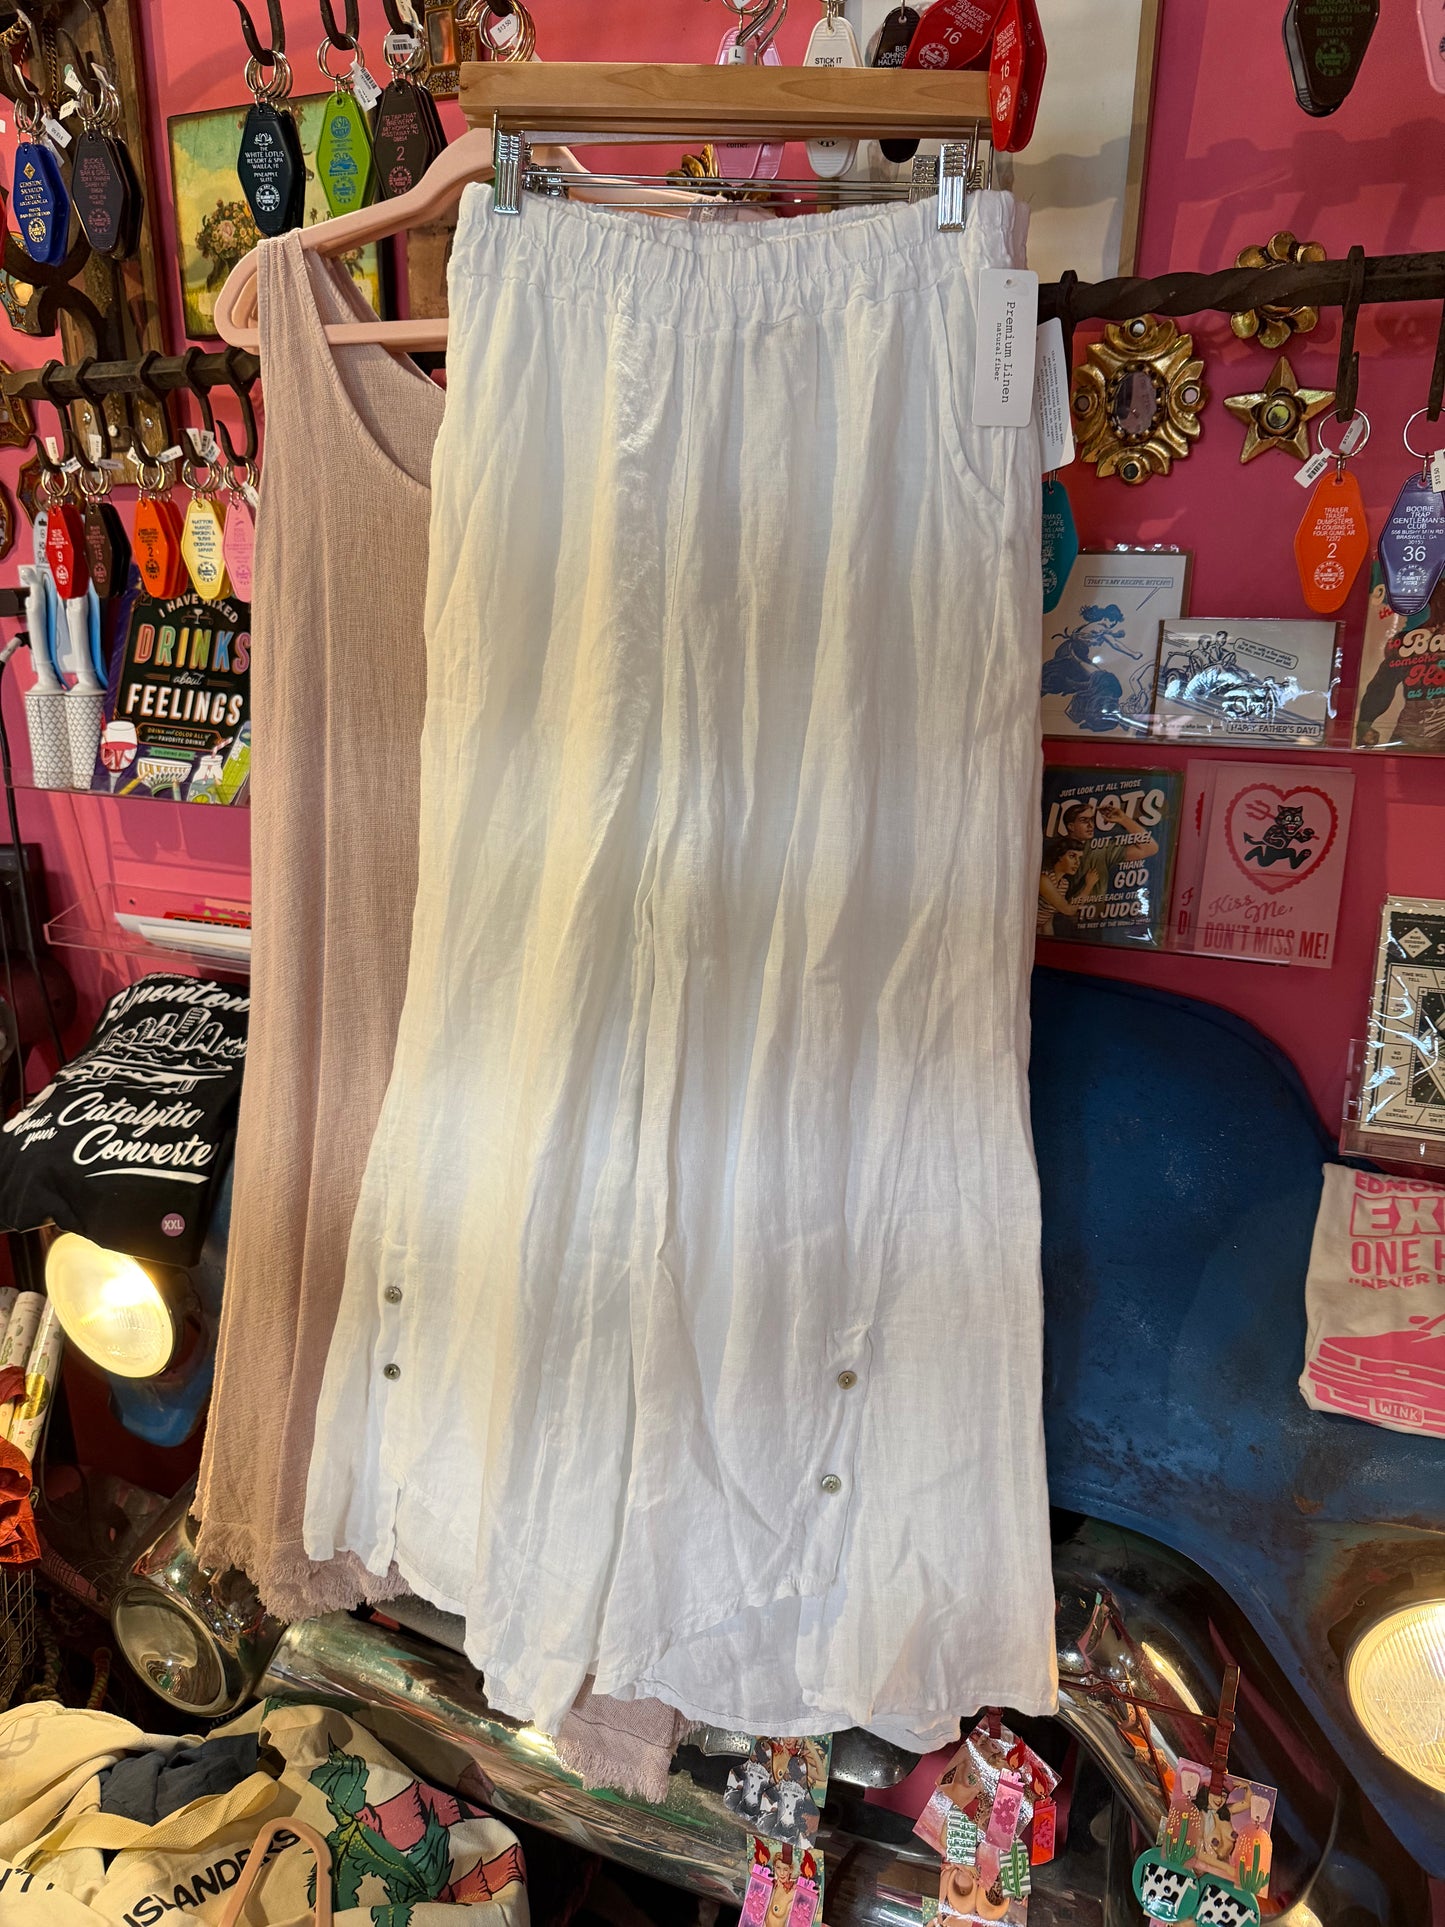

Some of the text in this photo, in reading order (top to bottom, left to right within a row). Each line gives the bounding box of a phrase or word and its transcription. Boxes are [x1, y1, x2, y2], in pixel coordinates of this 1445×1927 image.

[497, 19, 512, 33] $13.50
[943, 28, 963, 45] 16
[735, 49, 741, 58] L
[1001, 60, 1010, 80] 16
[265, 150, 284, 158] LOTUS
[396, 146, 405, 161] 2
[1002, 301, 1016, 404] Premium Linen
[57, 551, 64, 563] 9
[147, 547, 154, 557] 2
[1327, 543, 1337, 559] 2
[1402, 545, 1426, 562] 36
[159, 594, 239, 624] I HAVE MIXED
[134, 623, 250, 675] DRINKS
[1389, 653, 1438, 668] someone
[173, 672, 205, 686] about
[1407, 689, 1423, 698] as
[126, 683, 244, 727] FEELINGS
[1231, 724, 1257, 732] HAPPY
[1259, 724, 1295, 734] FATHER'S
[1296, 726, 1317, 735] DAY!
[158, 735, 185, 743] FAVORITE
[185, 738, 206, 746] DRINKS
[1059, 779, 1142, 798] JUST LOOK AT ALL THOSE
[1046, 789, 1166, 838] IDOTS
[1090, 830, 1152, 849] OUT THERE!
[1118, 859, 1145, 870] THANK
[1114, 869, 1149, 889] GOD
[1071, 891, 1150, 906] WE HAVE EACH OTHR
[1208, 894, 1255, 917] Kiss
[1078, 902, 1148, 920] TO JUDG
[1204, 921, 1329, 960] DON'T MISS ME!
[57, 1092, 205, 1137] Catalytic
[20, 1123, 58, 1151] your
[72, 1124, 219, 1166] Converte
[163, 1218, 183, 1231] XXL
[1351, 1239, 1421, 1276] ONE
[1379, 1402, 1420, 1423] WINK
